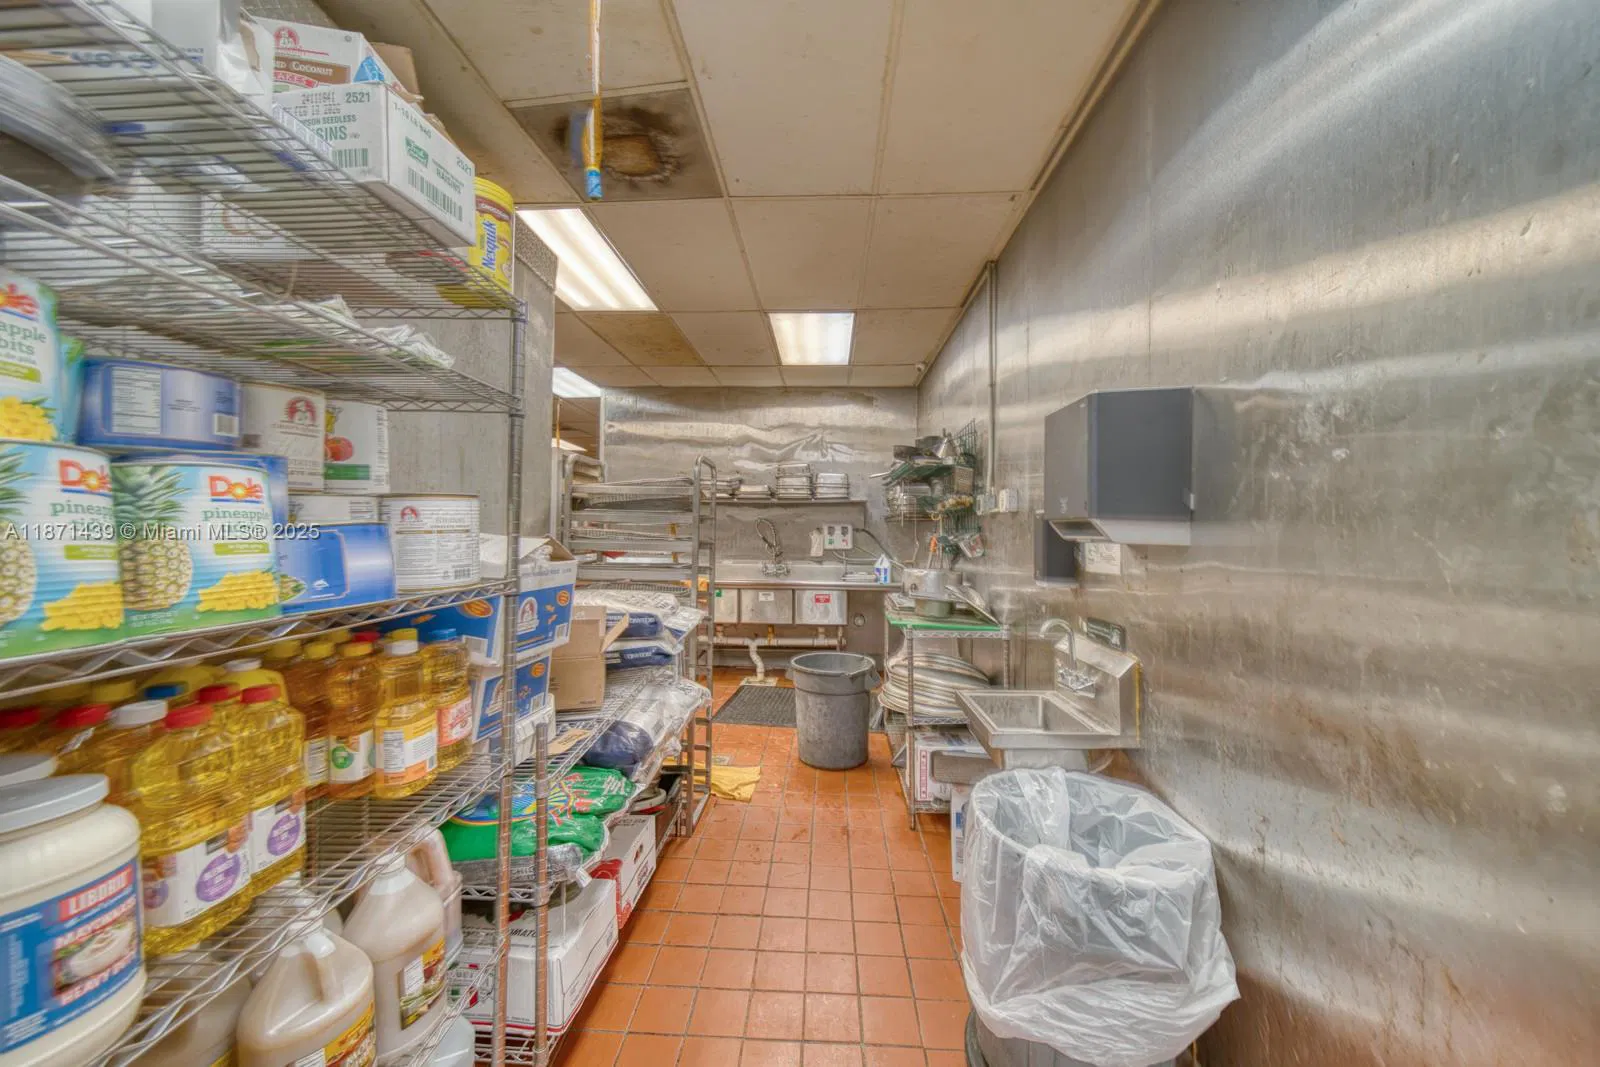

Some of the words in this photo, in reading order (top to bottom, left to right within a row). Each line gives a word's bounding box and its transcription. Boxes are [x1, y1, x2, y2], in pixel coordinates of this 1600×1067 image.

[345, 91, 371, 103] 2521
[322, 114, 357, 125] SEEDLESS
[316, 126, 348, 141] SINS
[482, 219, 500, 271] Nesquik
[0, 321, 47, 343] apple
[208, 475, 264, 499] Dole
[201, 507, 270, 522] pineapple
